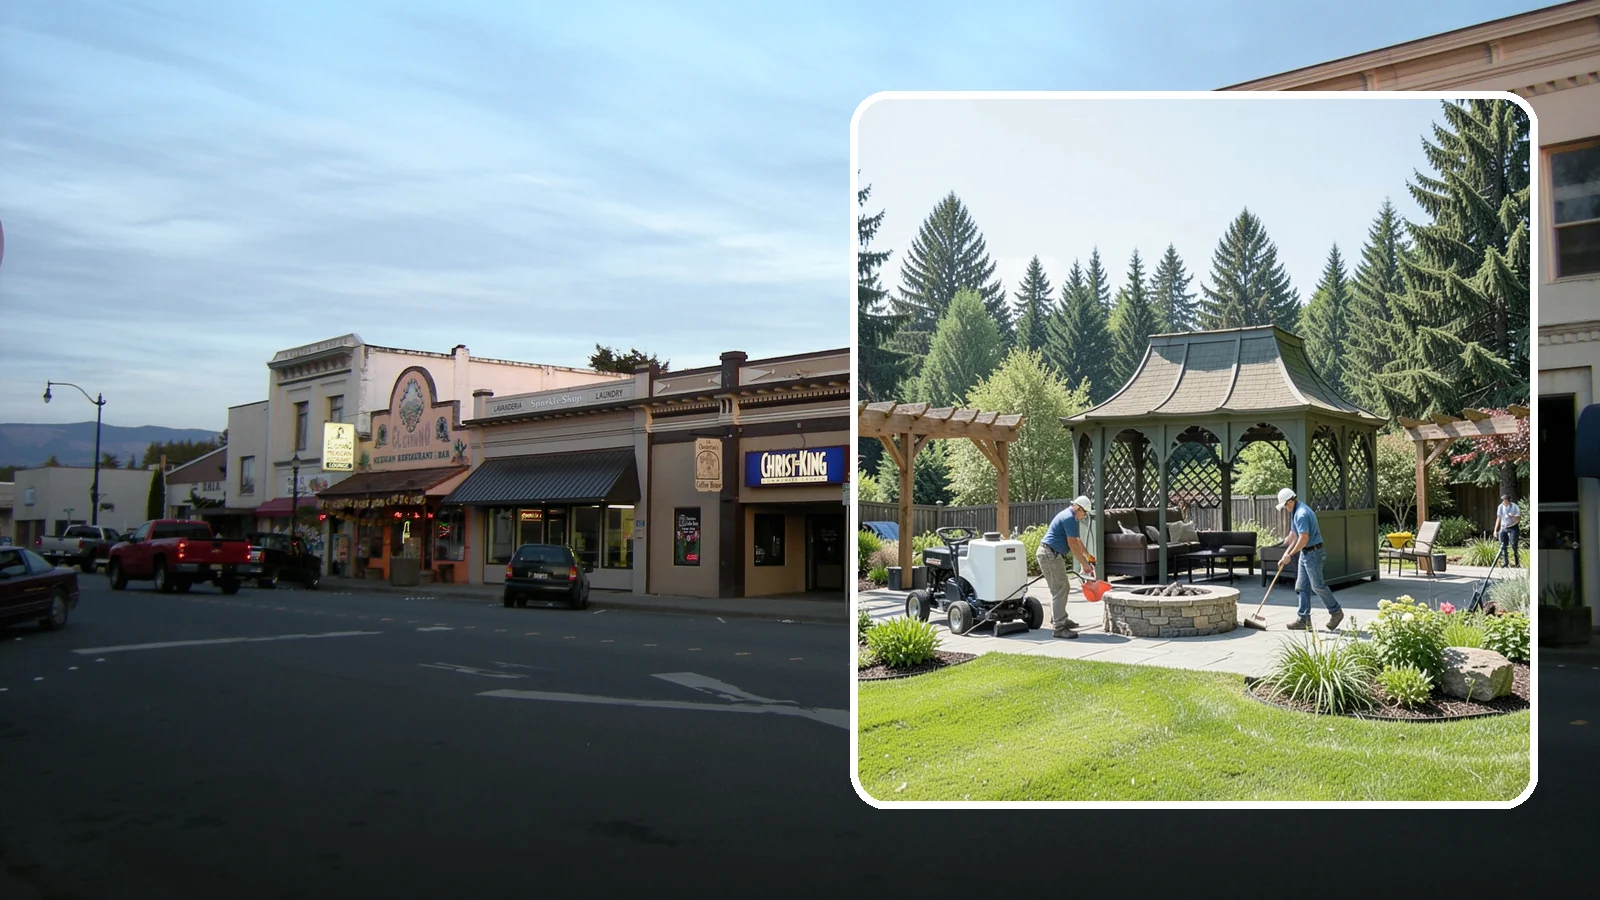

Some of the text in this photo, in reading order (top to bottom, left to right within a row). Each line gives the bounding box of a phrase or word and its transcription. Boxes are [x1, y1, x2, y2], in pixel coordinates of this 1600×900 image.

[561, 394, 582, 405] Shop
[595, 389, 623, 400] LAUNDRY
[493, 402, 522, 412] LAVANDERIA
[397, 451, 434, 462] RESTAURANT
[437, 449, 450, 458] BAR
[761, 450, 827, 478] CHRIST KING
